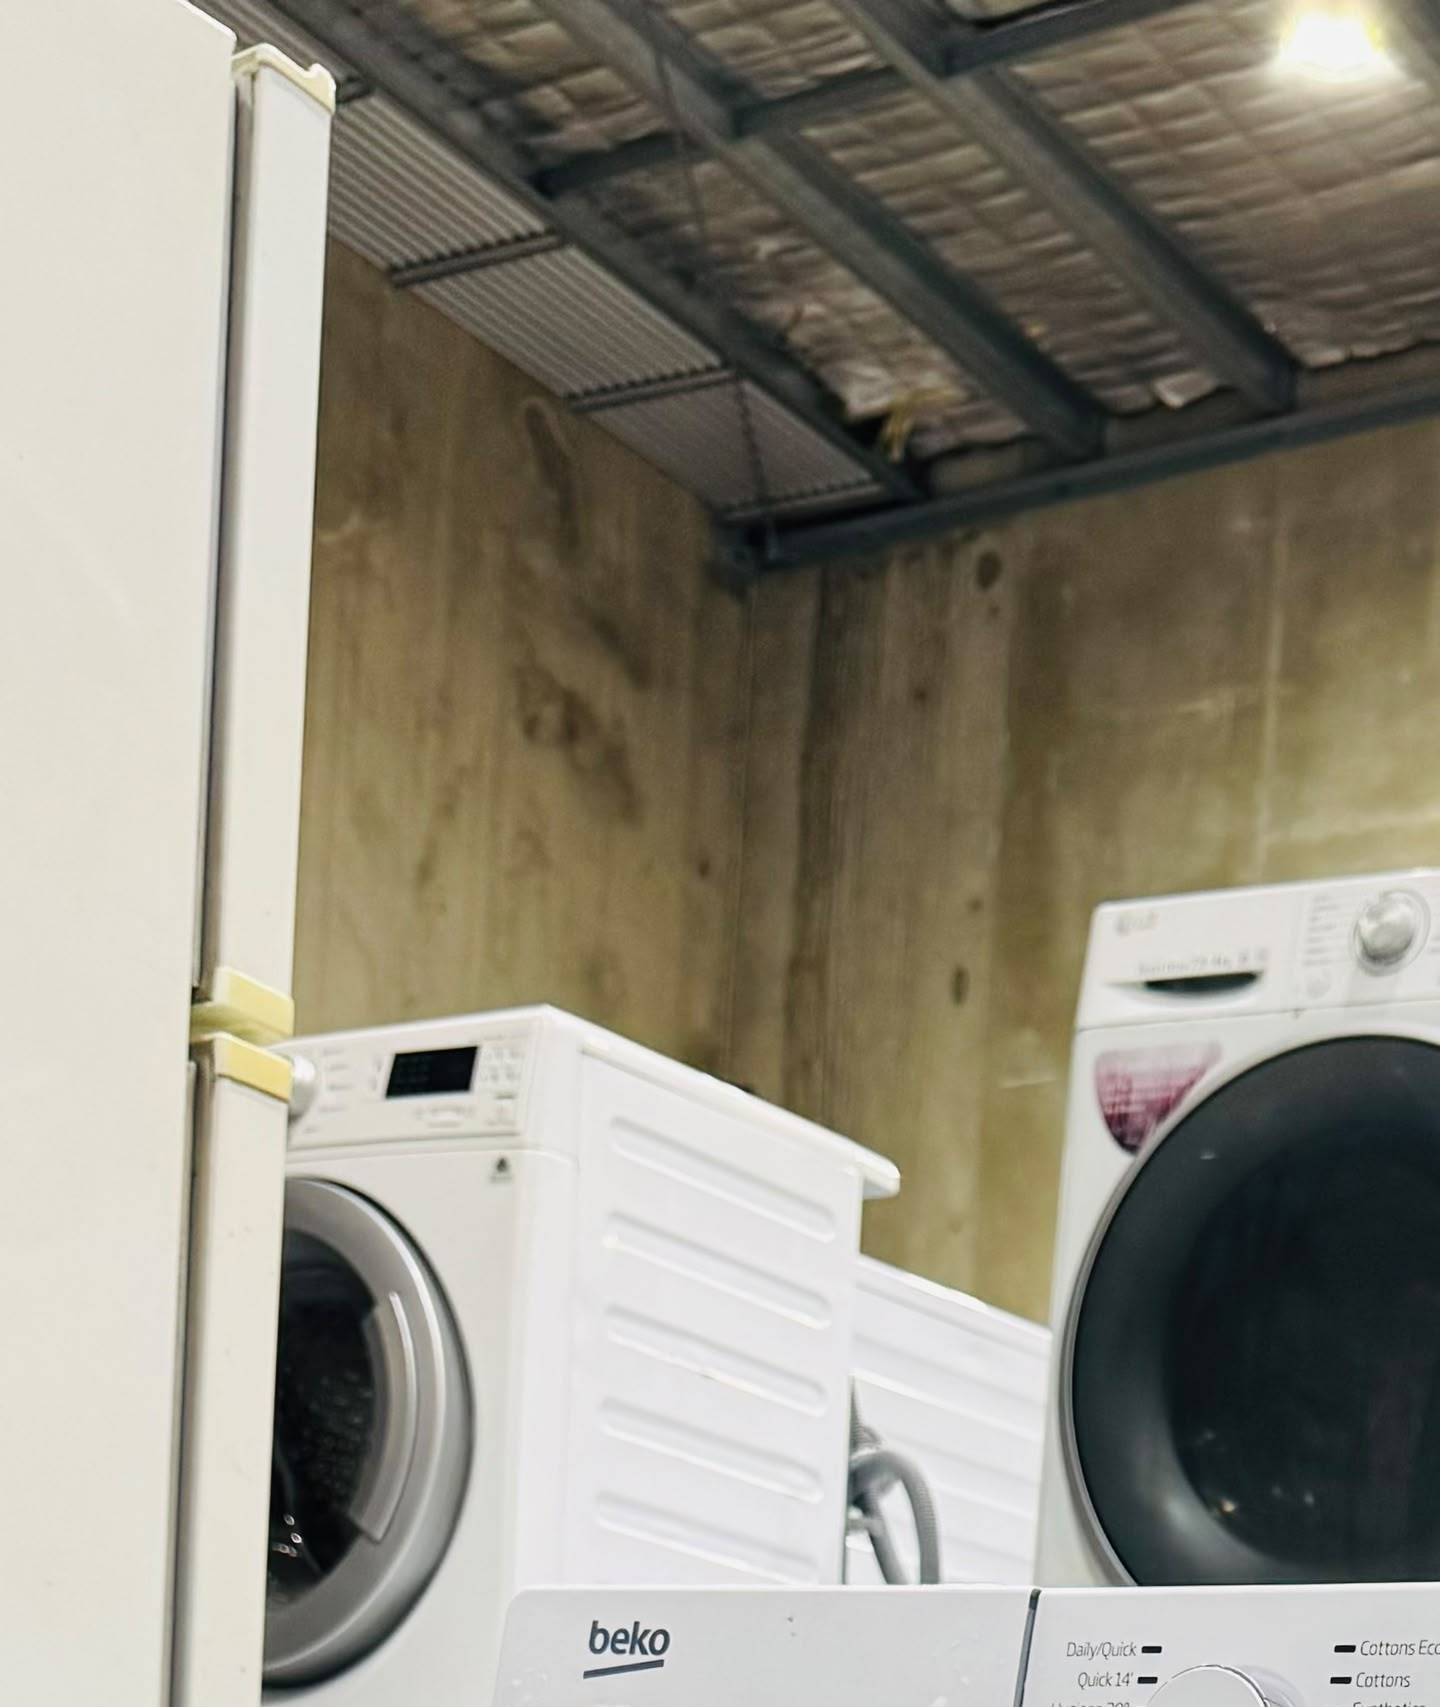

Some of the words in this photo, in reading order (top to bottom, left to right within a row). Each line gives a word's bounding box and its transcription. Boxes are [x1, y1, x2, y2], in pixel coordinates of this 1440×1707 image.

[588, 1619, 671, 1656] beko
[1066, 1641, 1138, 1661] Daily/Quick
[1360, 1640, 1416, 1656] Cottons
[1077, 1672, 1113, 1691] Quick
[1356, 1672, 1411, 1688] Cottons
